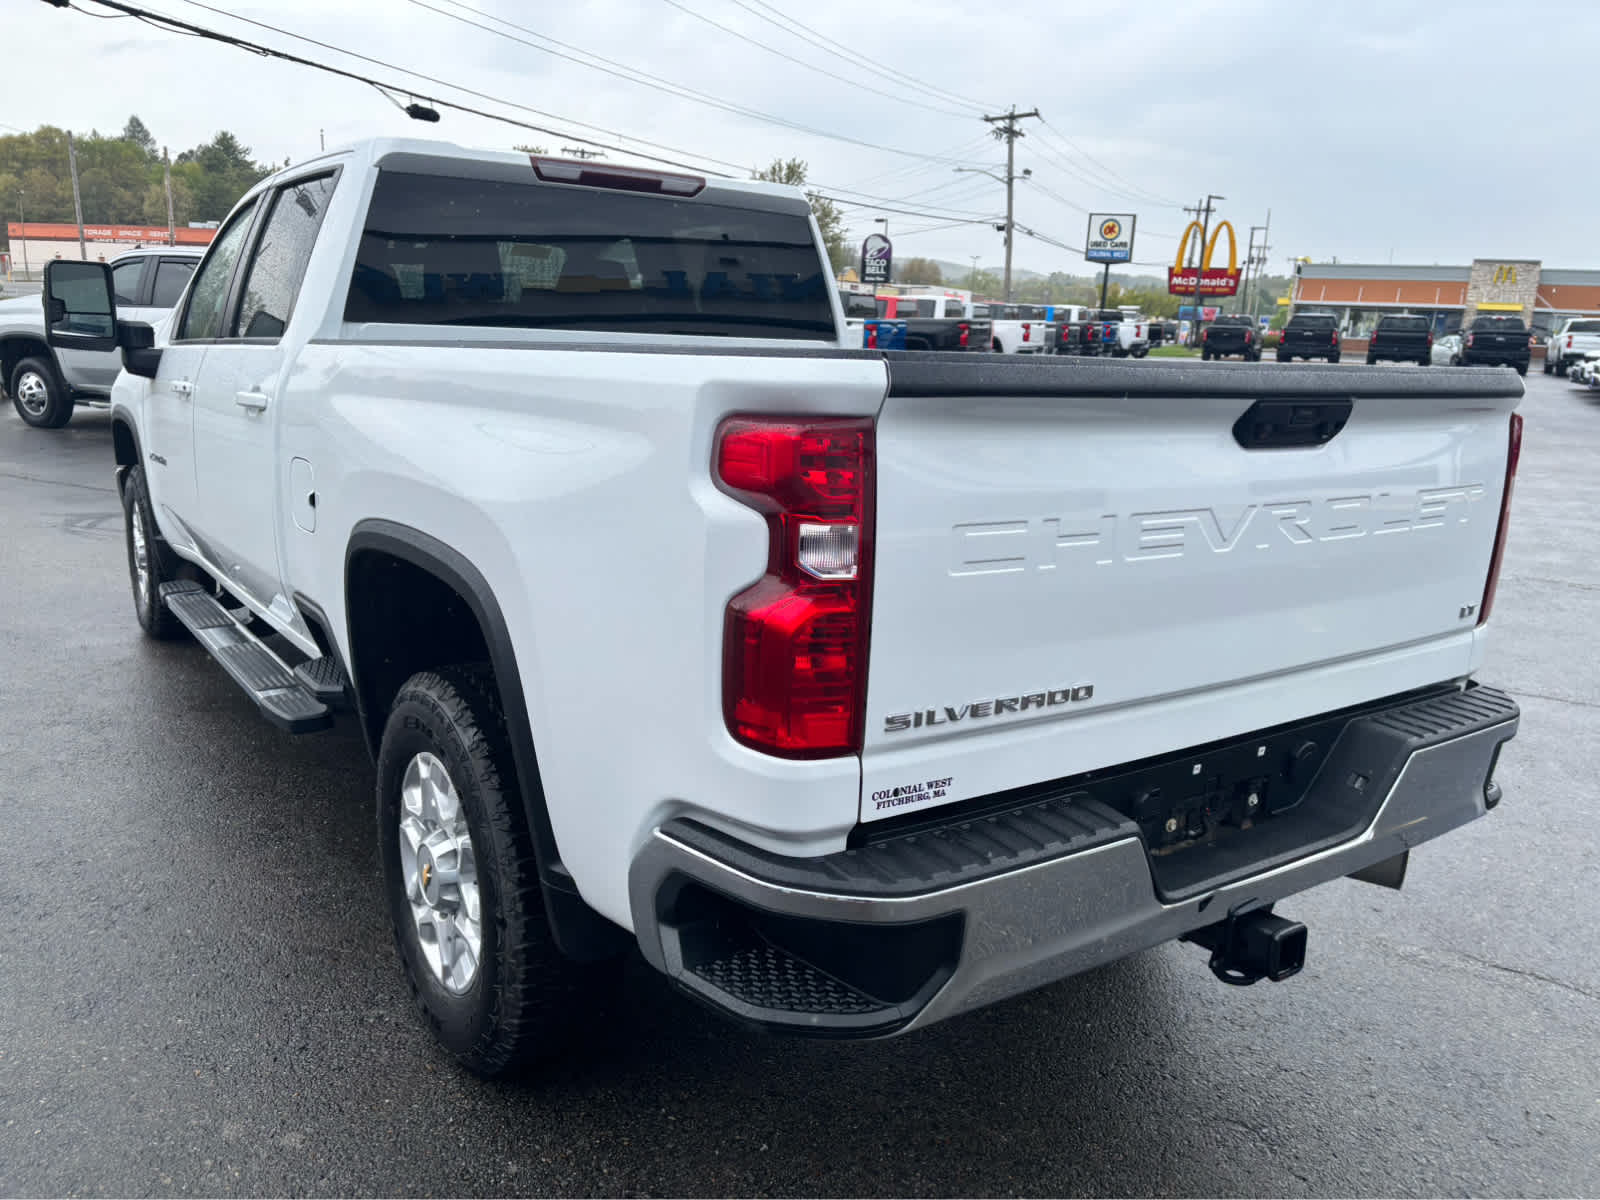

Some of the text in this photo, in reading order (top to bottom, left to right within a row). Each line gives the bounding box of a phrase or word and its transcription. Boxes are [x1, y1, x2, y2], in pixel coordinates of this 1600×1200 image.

[1110, 241, 1129, 249] CARS
[865, 258, 887, 266] TACO
[865, 266, 887, 274] BELL
[948, 484, 1484, 577] CHEVROLET
[884, 682, 1095, 733] SILVERADO
[872, 777, 953, 802] COLONIAL WEST
[876, 789, 947, 810] FITCHBURG, MA
